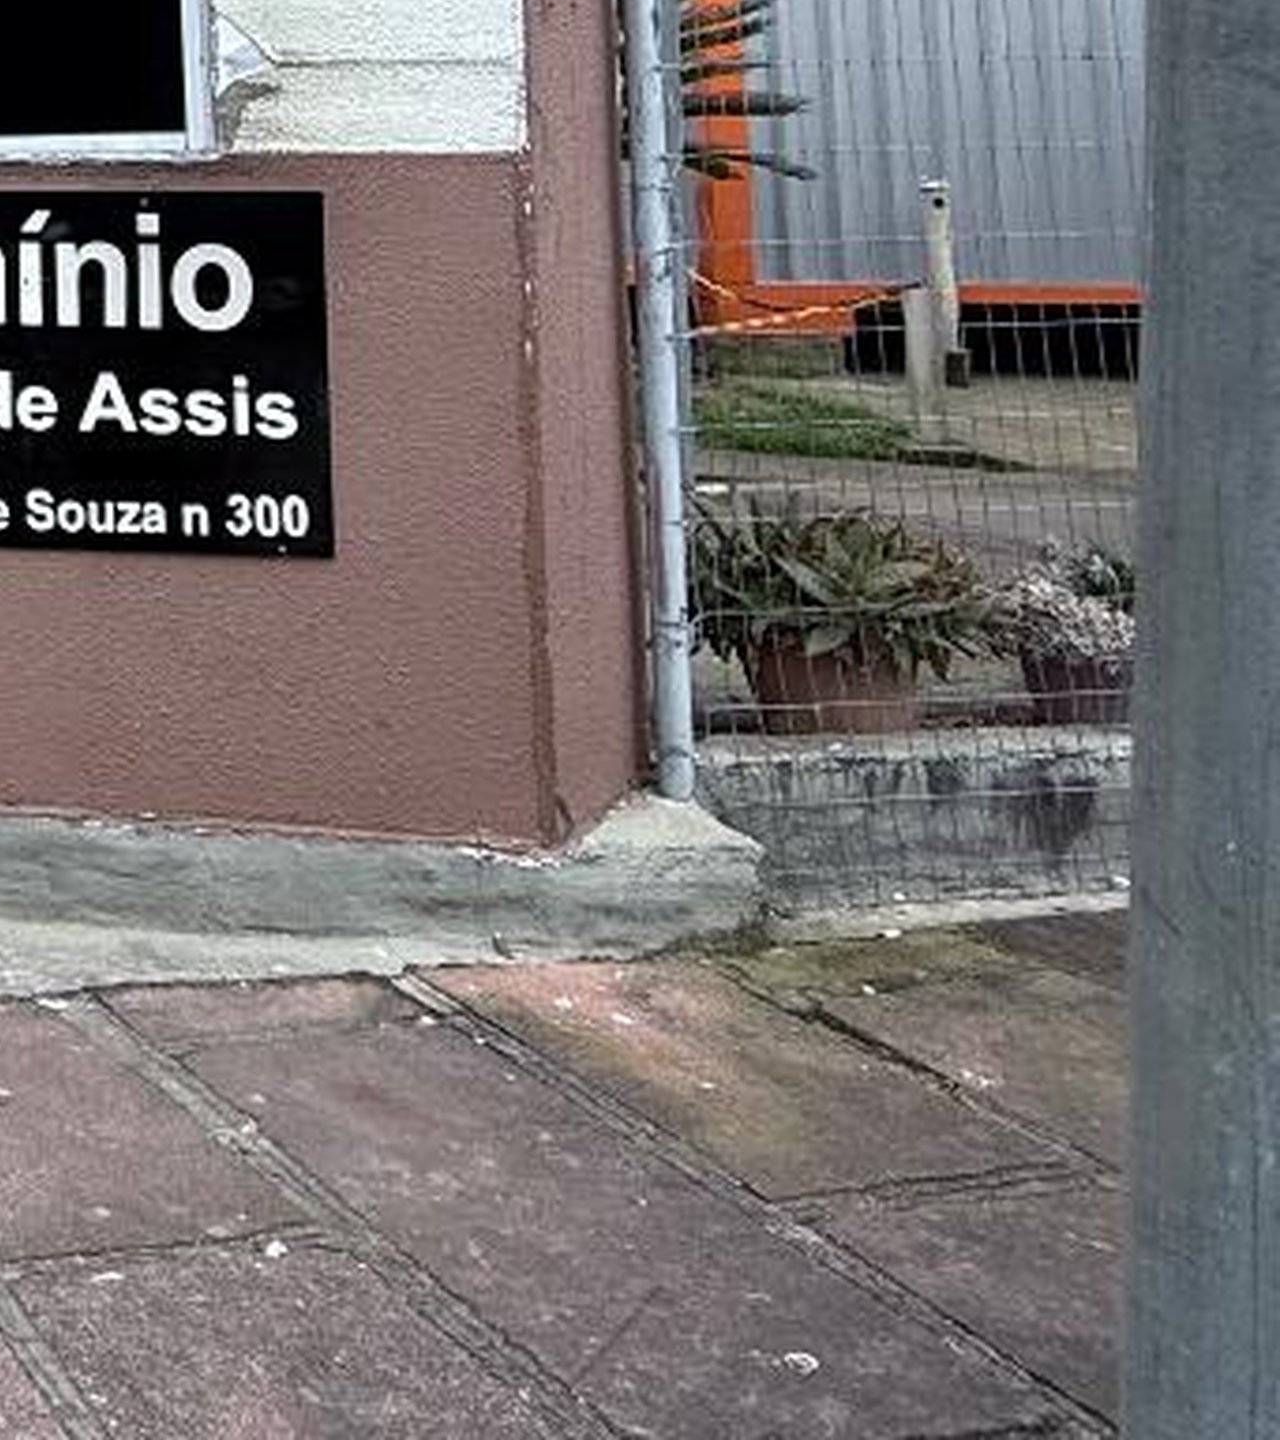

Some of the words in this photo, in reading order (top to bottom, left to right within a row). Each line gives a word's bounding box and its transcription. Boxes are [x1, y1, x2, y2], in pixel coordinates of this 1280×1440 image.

[79, 373, 298, 439] Assis
[27, 490, 166, 533] Souza
[182, 505, 208, 535] n
[226, 494, 309, 537] 300
